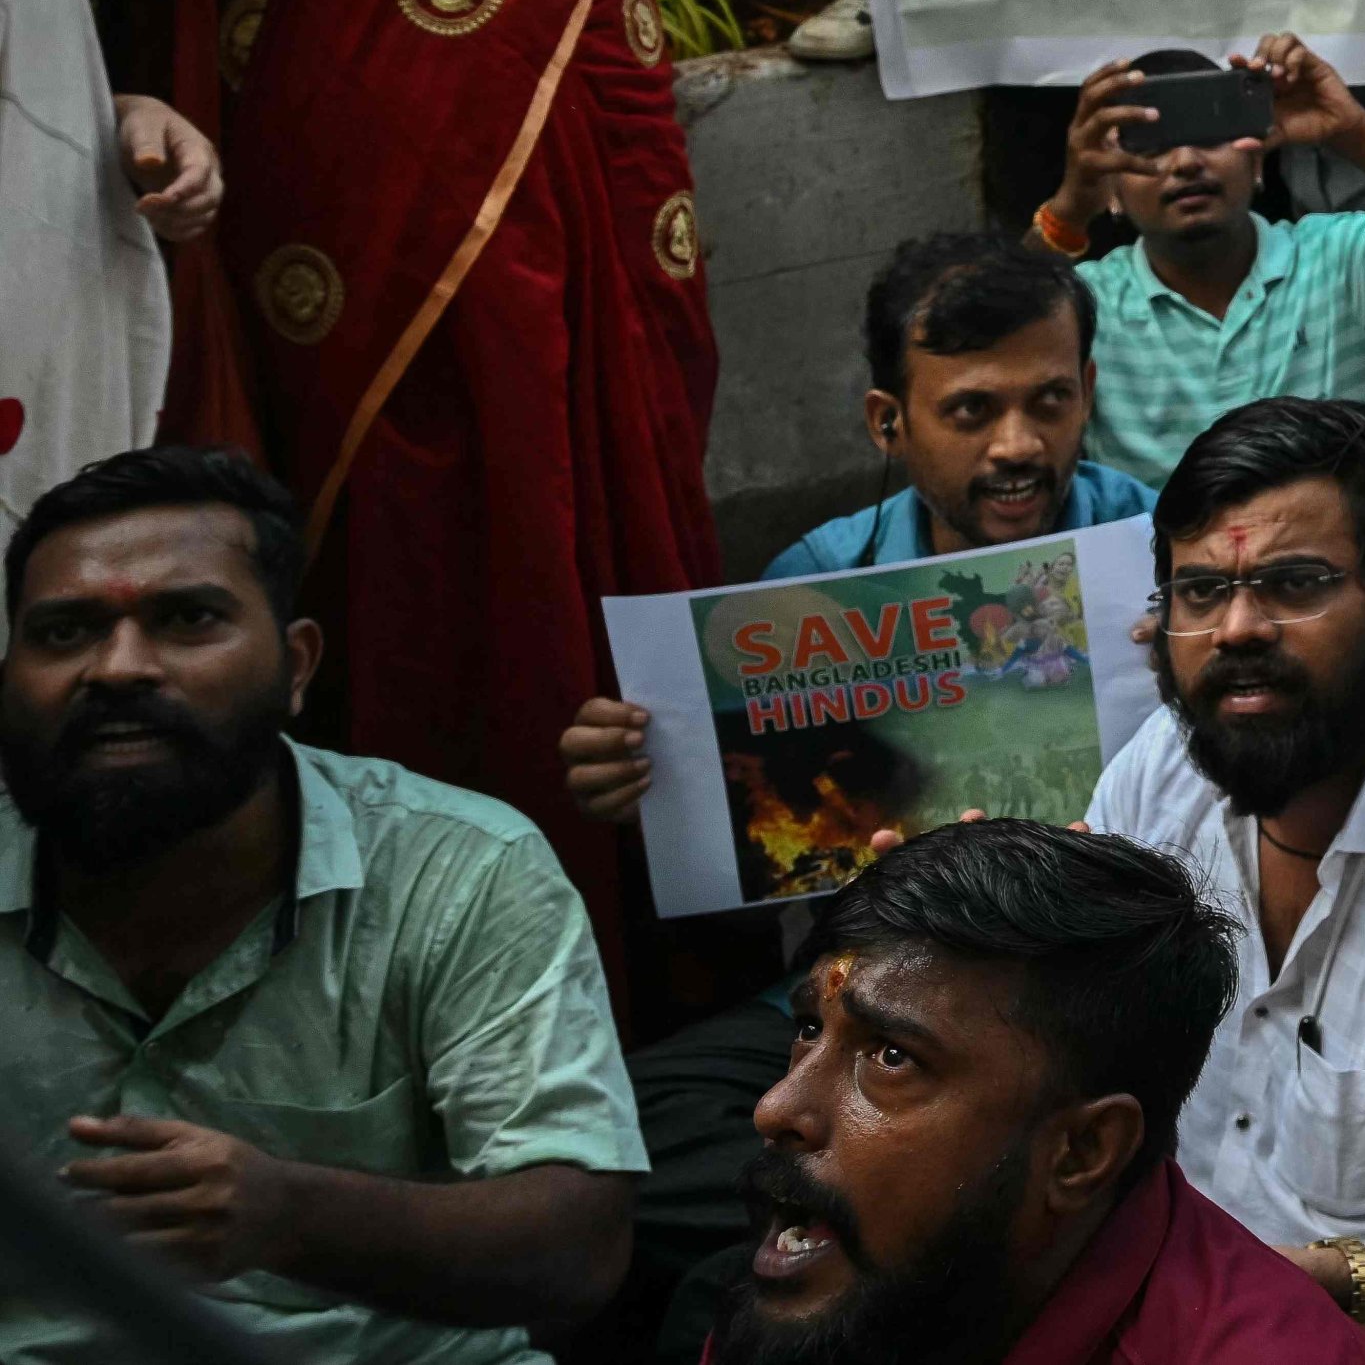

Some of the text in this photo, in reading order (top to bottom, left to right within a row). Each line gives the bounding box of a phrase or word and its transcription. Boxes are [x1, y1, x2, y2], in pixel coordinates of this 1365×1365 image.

[732, 595, 960, 677] SAVE
[743, 649, 964, 699] BANGLADESHI
[744, 670, 968, 737] HINDUS
